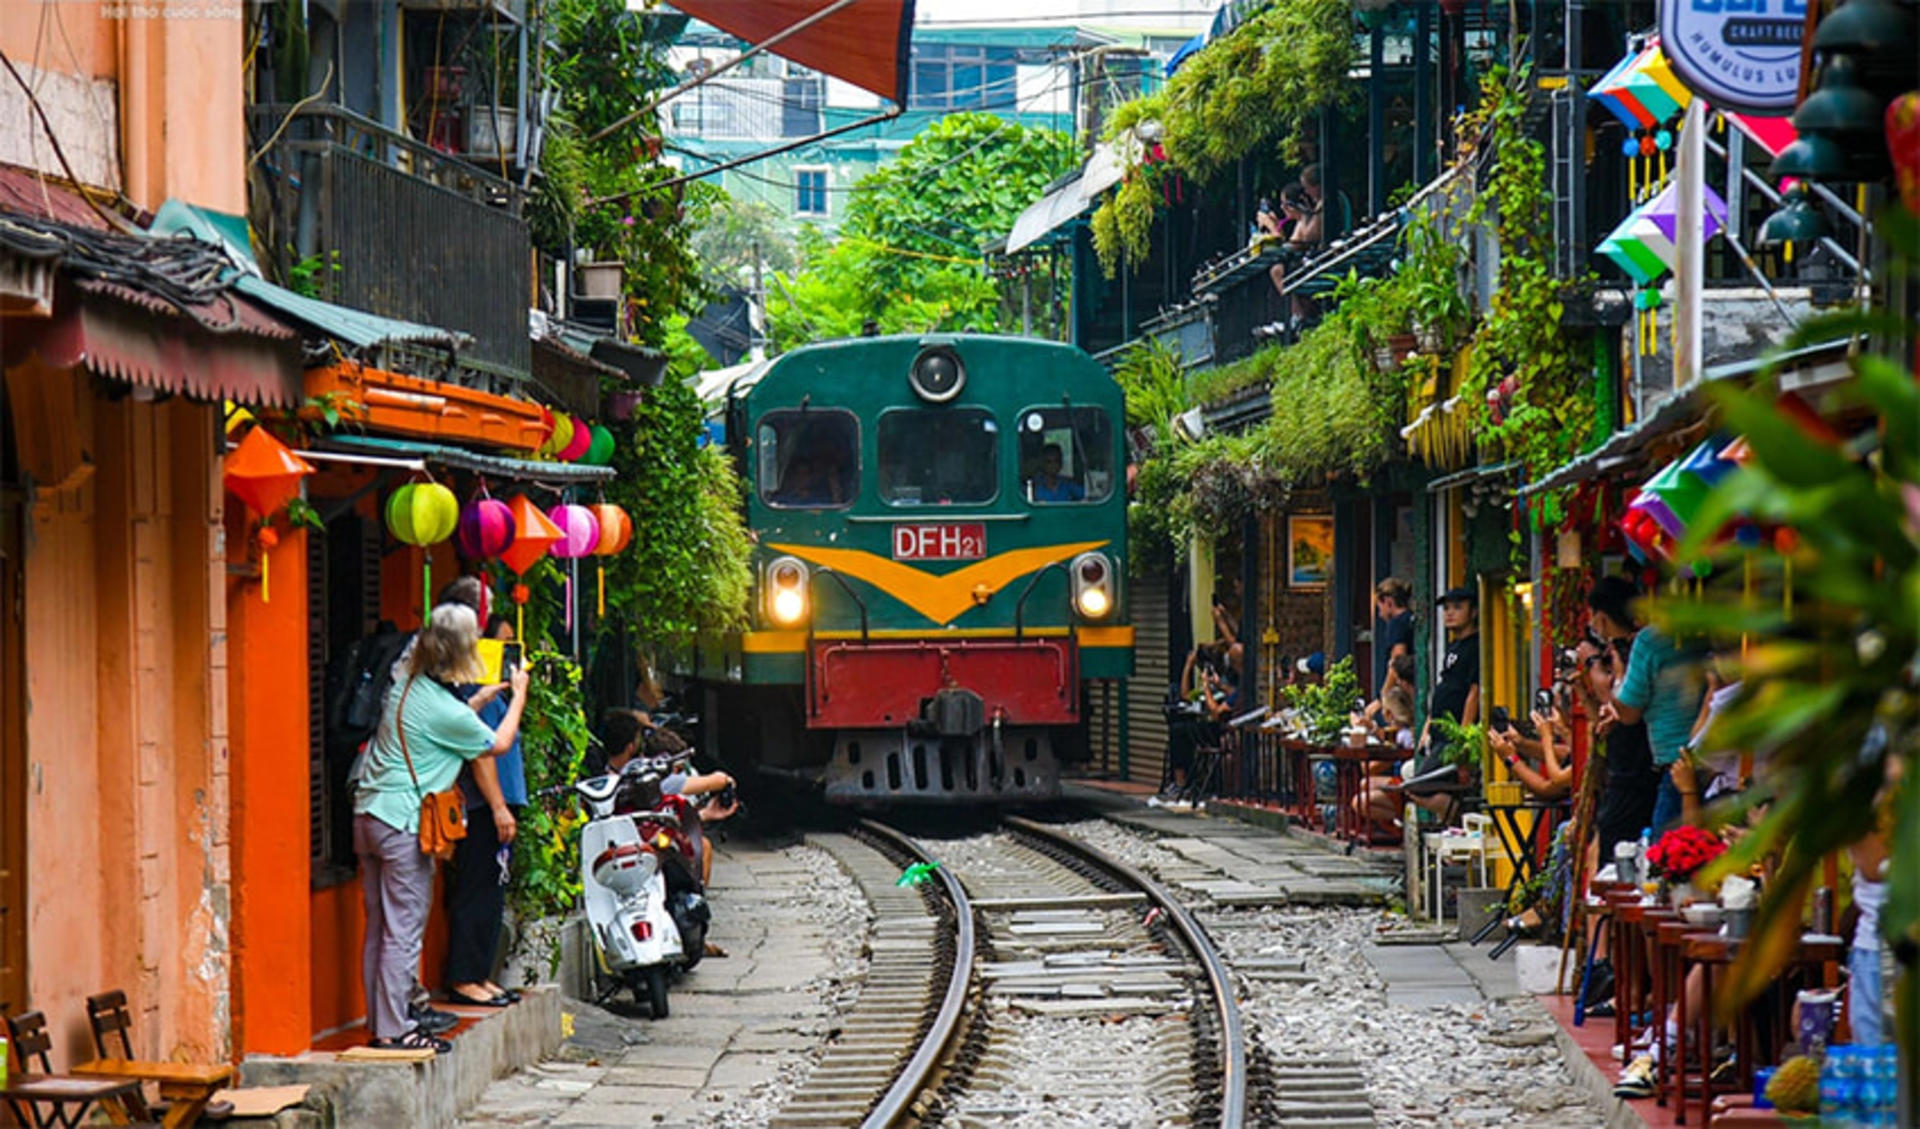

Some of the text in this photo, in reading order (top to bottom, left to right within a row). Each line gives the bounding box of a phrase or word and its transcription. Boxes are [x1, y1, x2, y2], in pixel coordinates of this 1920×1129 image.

[1730, 24, 1773, 38] CRAFT
[1690, 31, 1798, 84] HUMULUS LU
